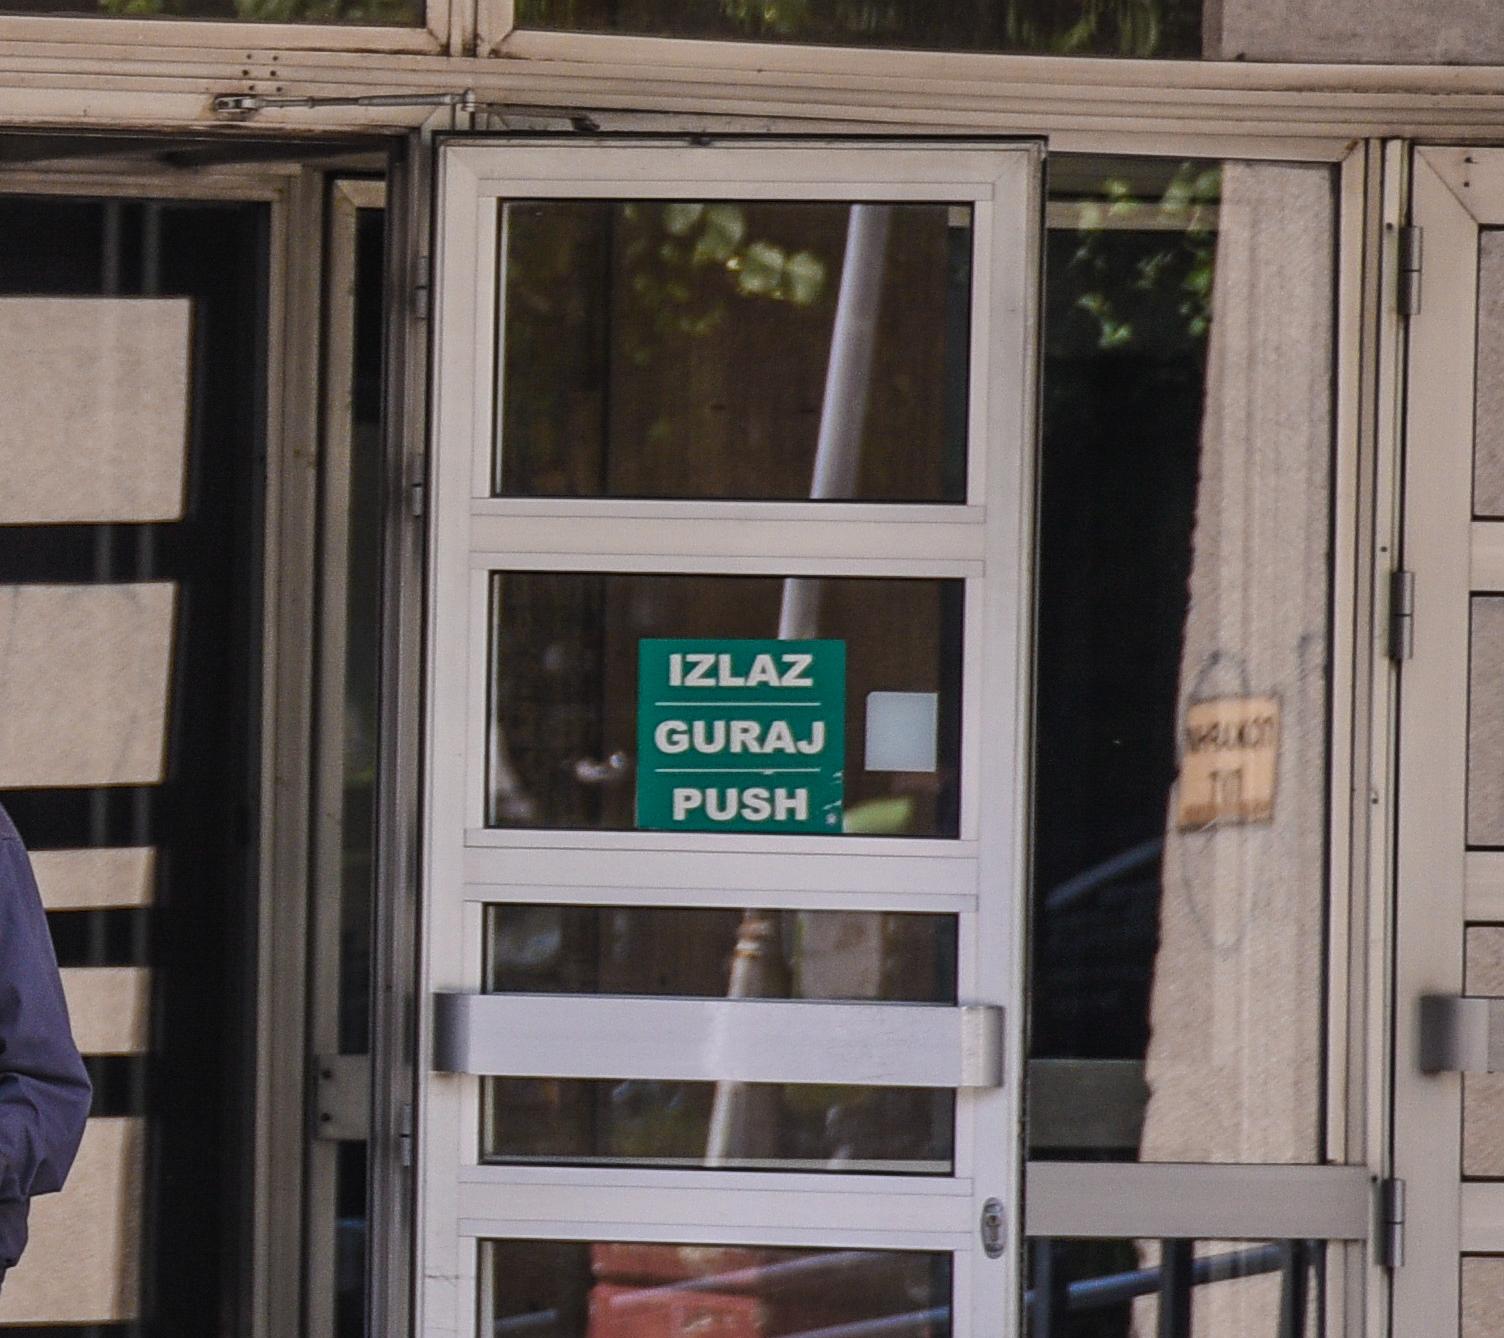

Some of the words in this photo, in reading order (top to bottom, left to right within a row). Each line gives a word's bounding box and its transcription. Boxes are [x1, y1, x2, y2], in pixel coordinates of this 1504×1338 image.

[669, 653, 814, 688] IZLAZ
[654, 719, 826, 755] GURAJ
[673, 787, 808, 822] PUSH
